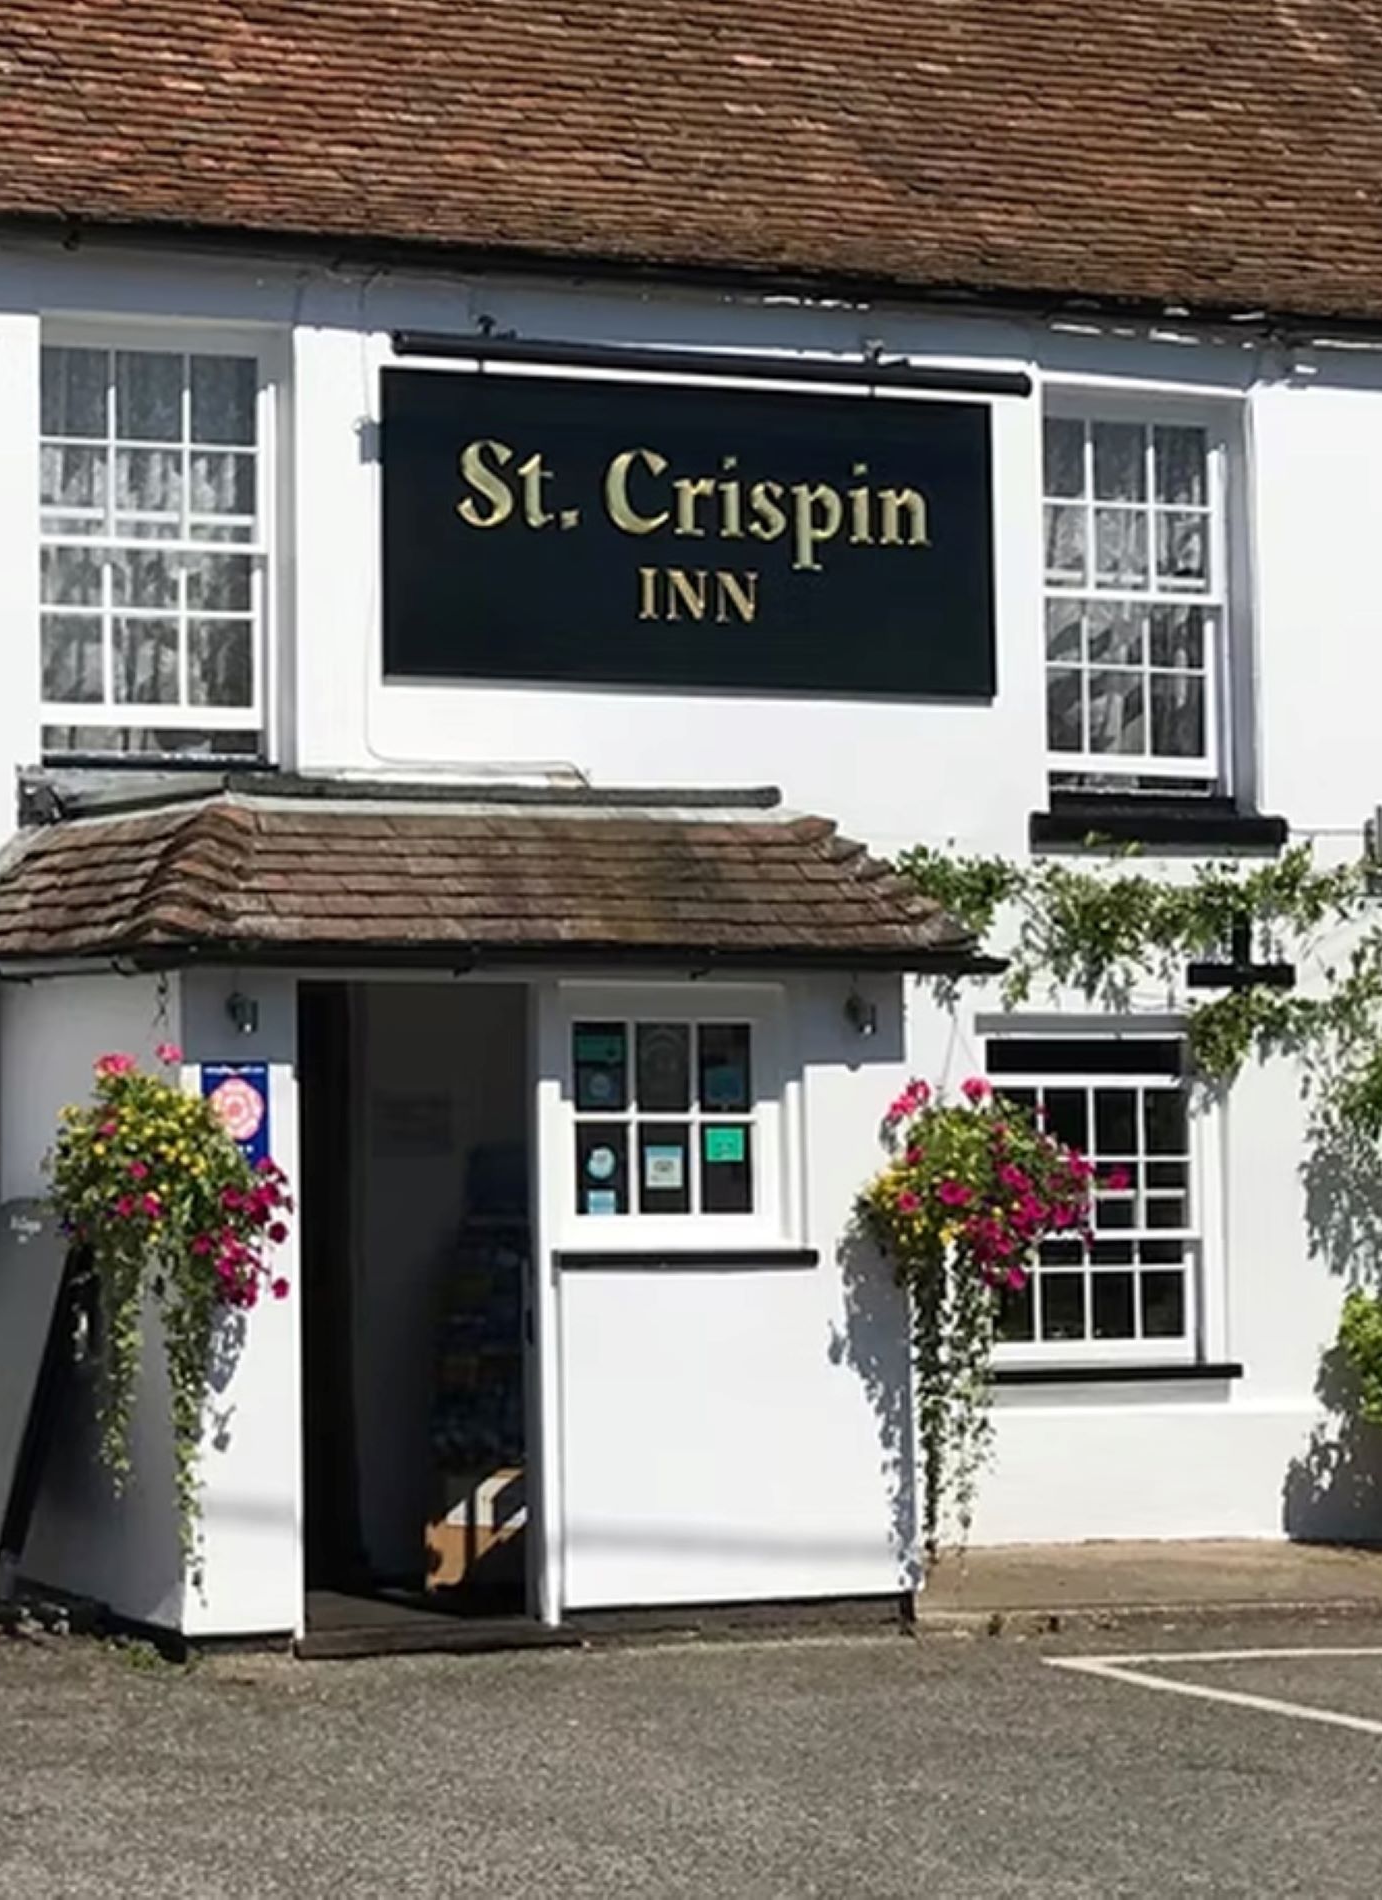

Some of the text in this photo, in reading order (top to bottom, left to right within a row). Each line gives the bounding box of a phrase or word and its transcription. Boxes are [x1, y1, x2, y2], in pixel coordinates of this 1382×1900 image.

[456, 438, 933, 571] St. Crispin
[637, 565, 759, 624] INN
